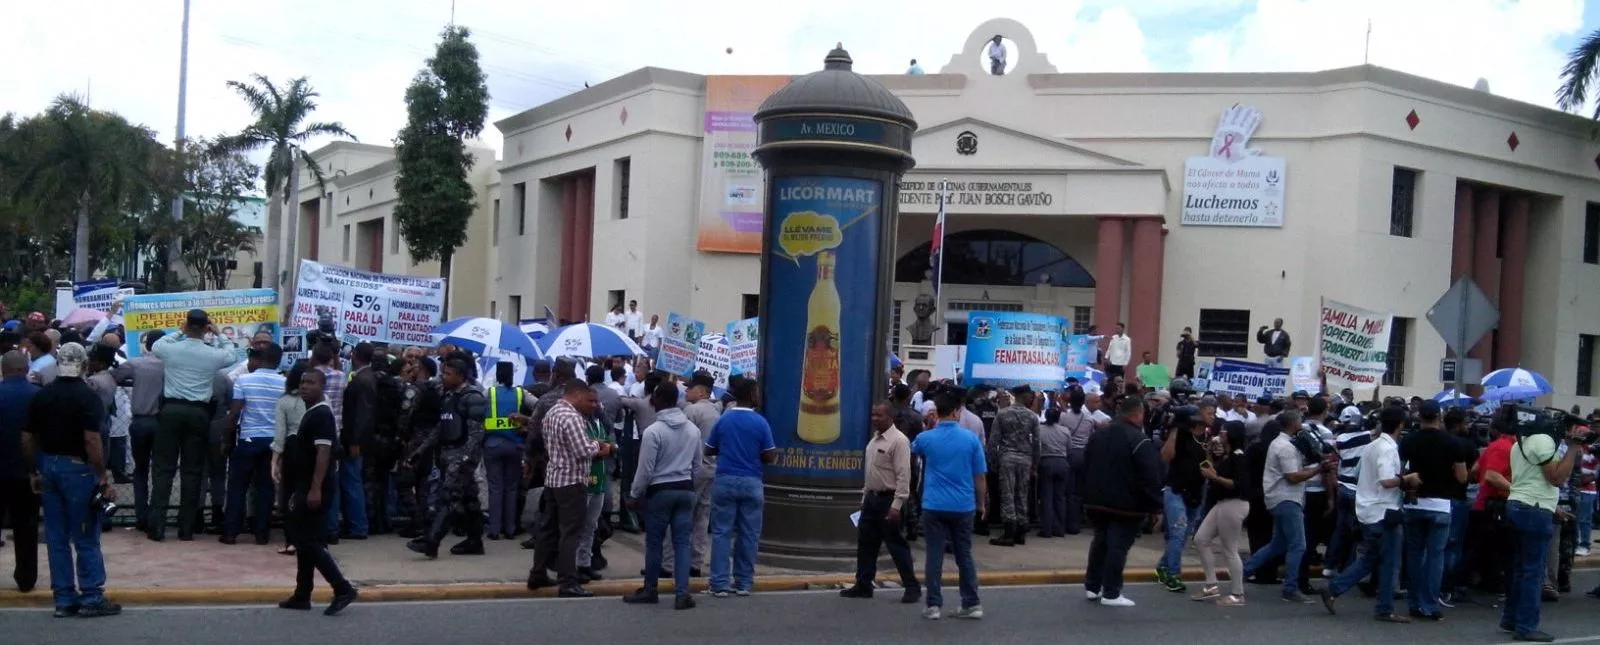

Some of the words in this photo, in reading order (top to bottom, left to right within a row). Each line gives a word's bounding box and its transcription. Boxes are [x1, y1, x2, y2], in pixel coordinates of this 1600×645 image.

[816, 123, 855, 135] MEXICO
[780, 186, 875, 203] LICORMART
[900, 192, 932, 204] IDENTE
[958, 193, 983, 205] JUAN
[985, 193, 1015, 206] BOSCH
[1016, 191, 1053, 206] GAVIÑO
[1185, 194, 1260, 210] Luchemos
[1184, 211, 1211, 222] hasta
[1212, 212, 1258, 223] detenerlo
[352, 294, 381, 312] 5%
[391, 300, 440, 313] NOMBRAMIENTOS
[207, 309, 267, 317] GRESIONES
[344, 310, 368, 324] PARA
[371, 314, 384, 325] LA
[398, 311, 415, 322] PARA
[417, 313, 430, 323] LOS
[1322, 307, 1358, 331] FAMILIA
[345, 323, 377, 337] SALUD
[391, 331, 405, 341] POR
[406, 333, 433, 344] CUOTAS
[1212, 371, 1264, 388] APLICACIÓN
[782, 455, 807, 468] JOHN
[818, 456, 863, 470] KENNEDY
